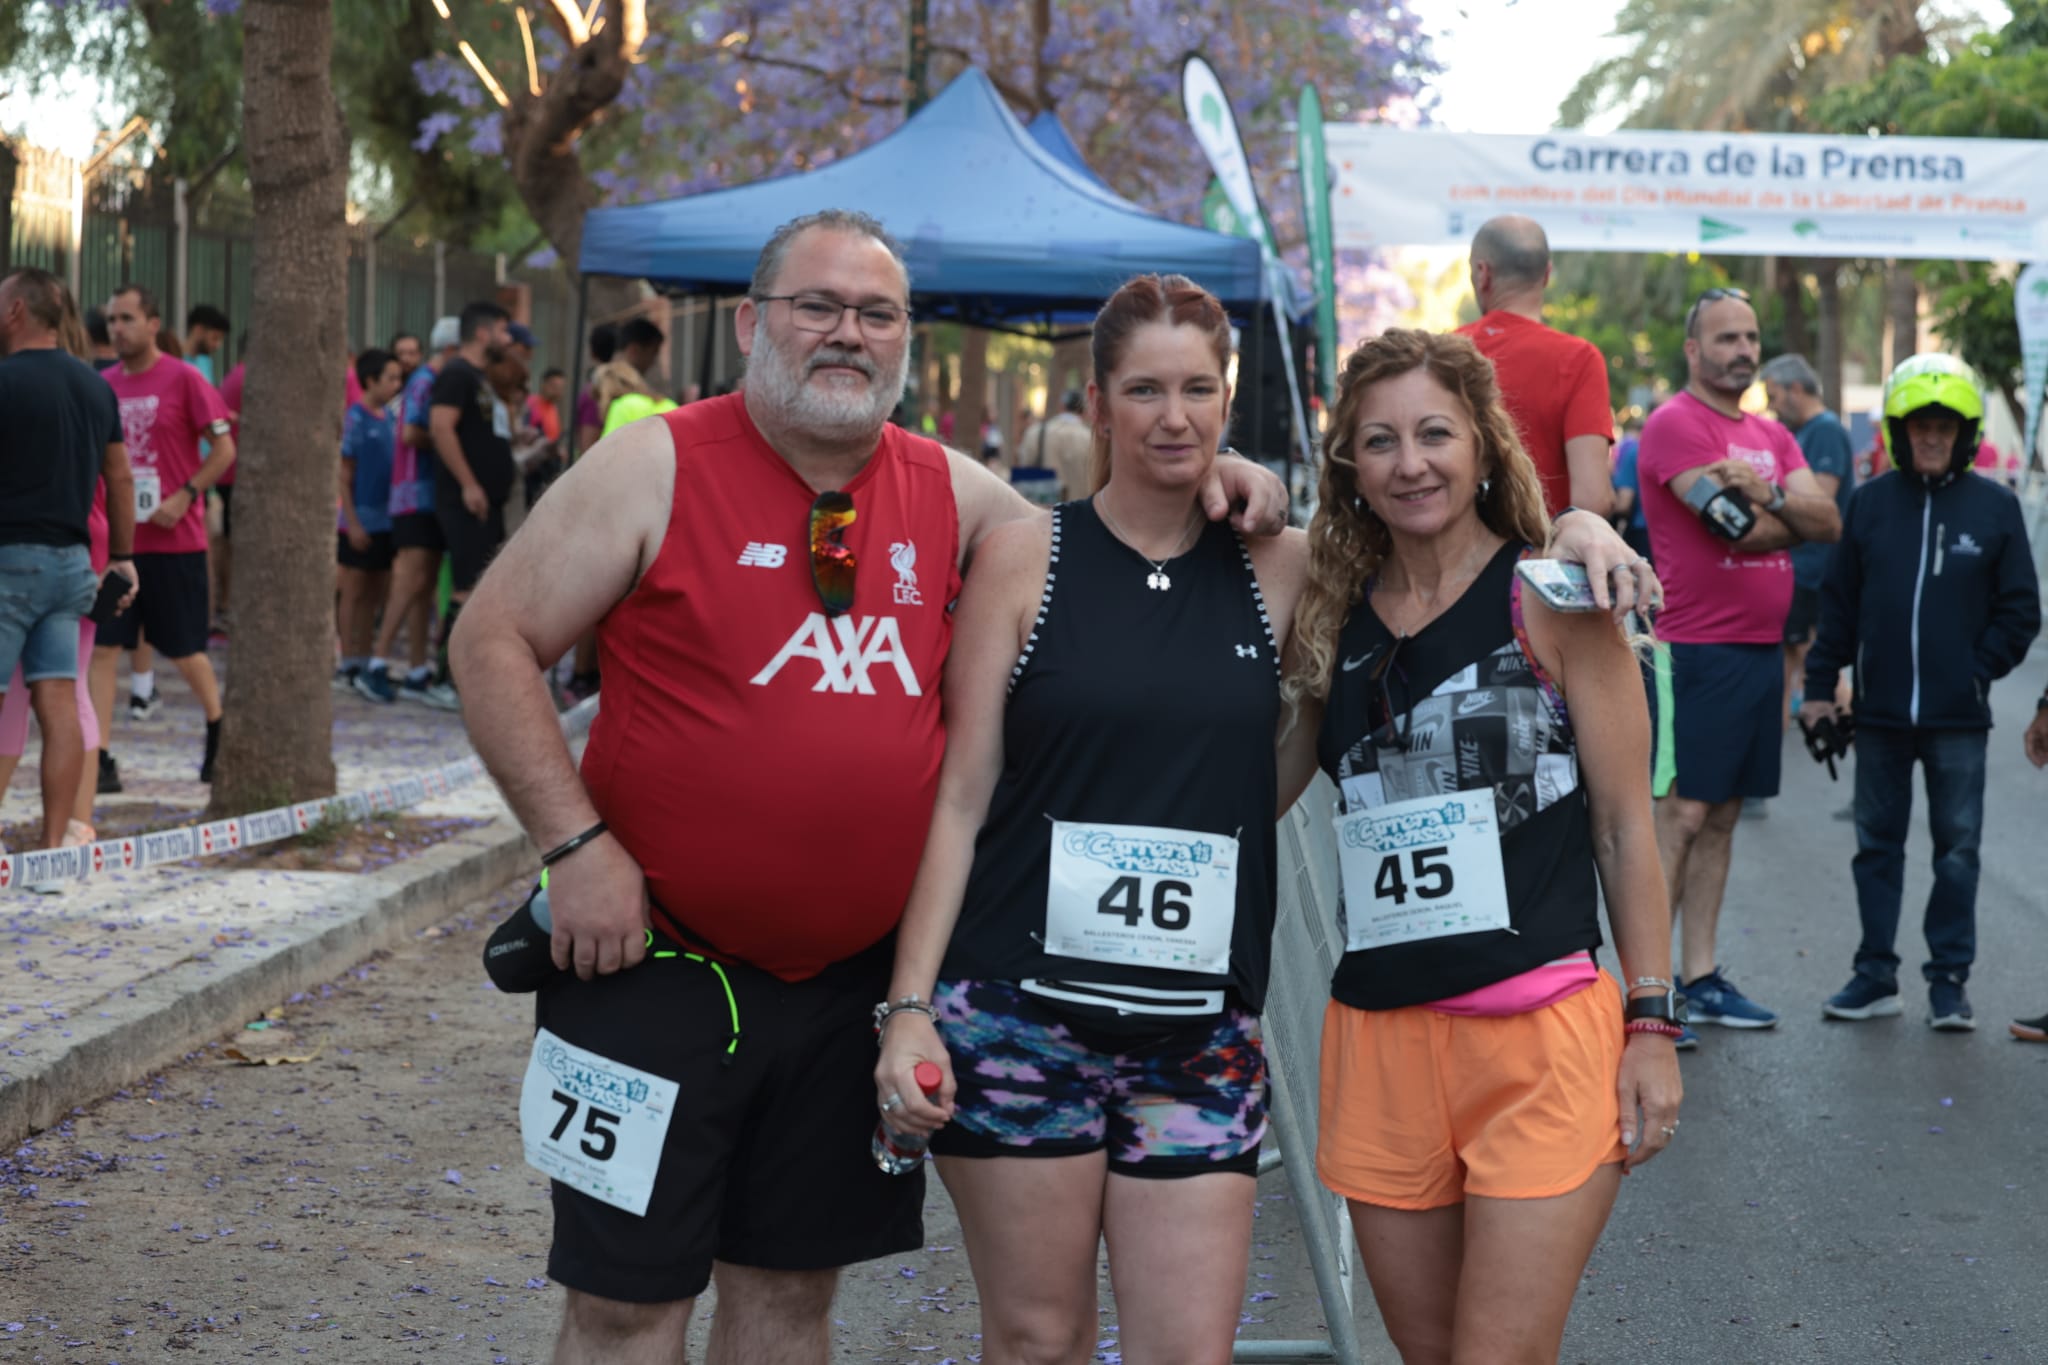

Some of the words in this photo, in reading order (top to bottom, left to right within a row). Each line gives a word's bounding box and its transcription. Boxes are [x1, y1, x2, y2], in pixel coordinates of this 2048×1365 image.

[1531, 139, 1689, 175] Carrera
[1704, 144, 1756, 177] de
[1771, 144, 1805, 178] la
[1822, 147, 1965, 181] Prensa
[749, 611, 923, 697] AXA
[1097, 875, 1193, 931] 46
[1373, 845, 1454, 906] 45
[549, 1088, 622, 1162] 75
